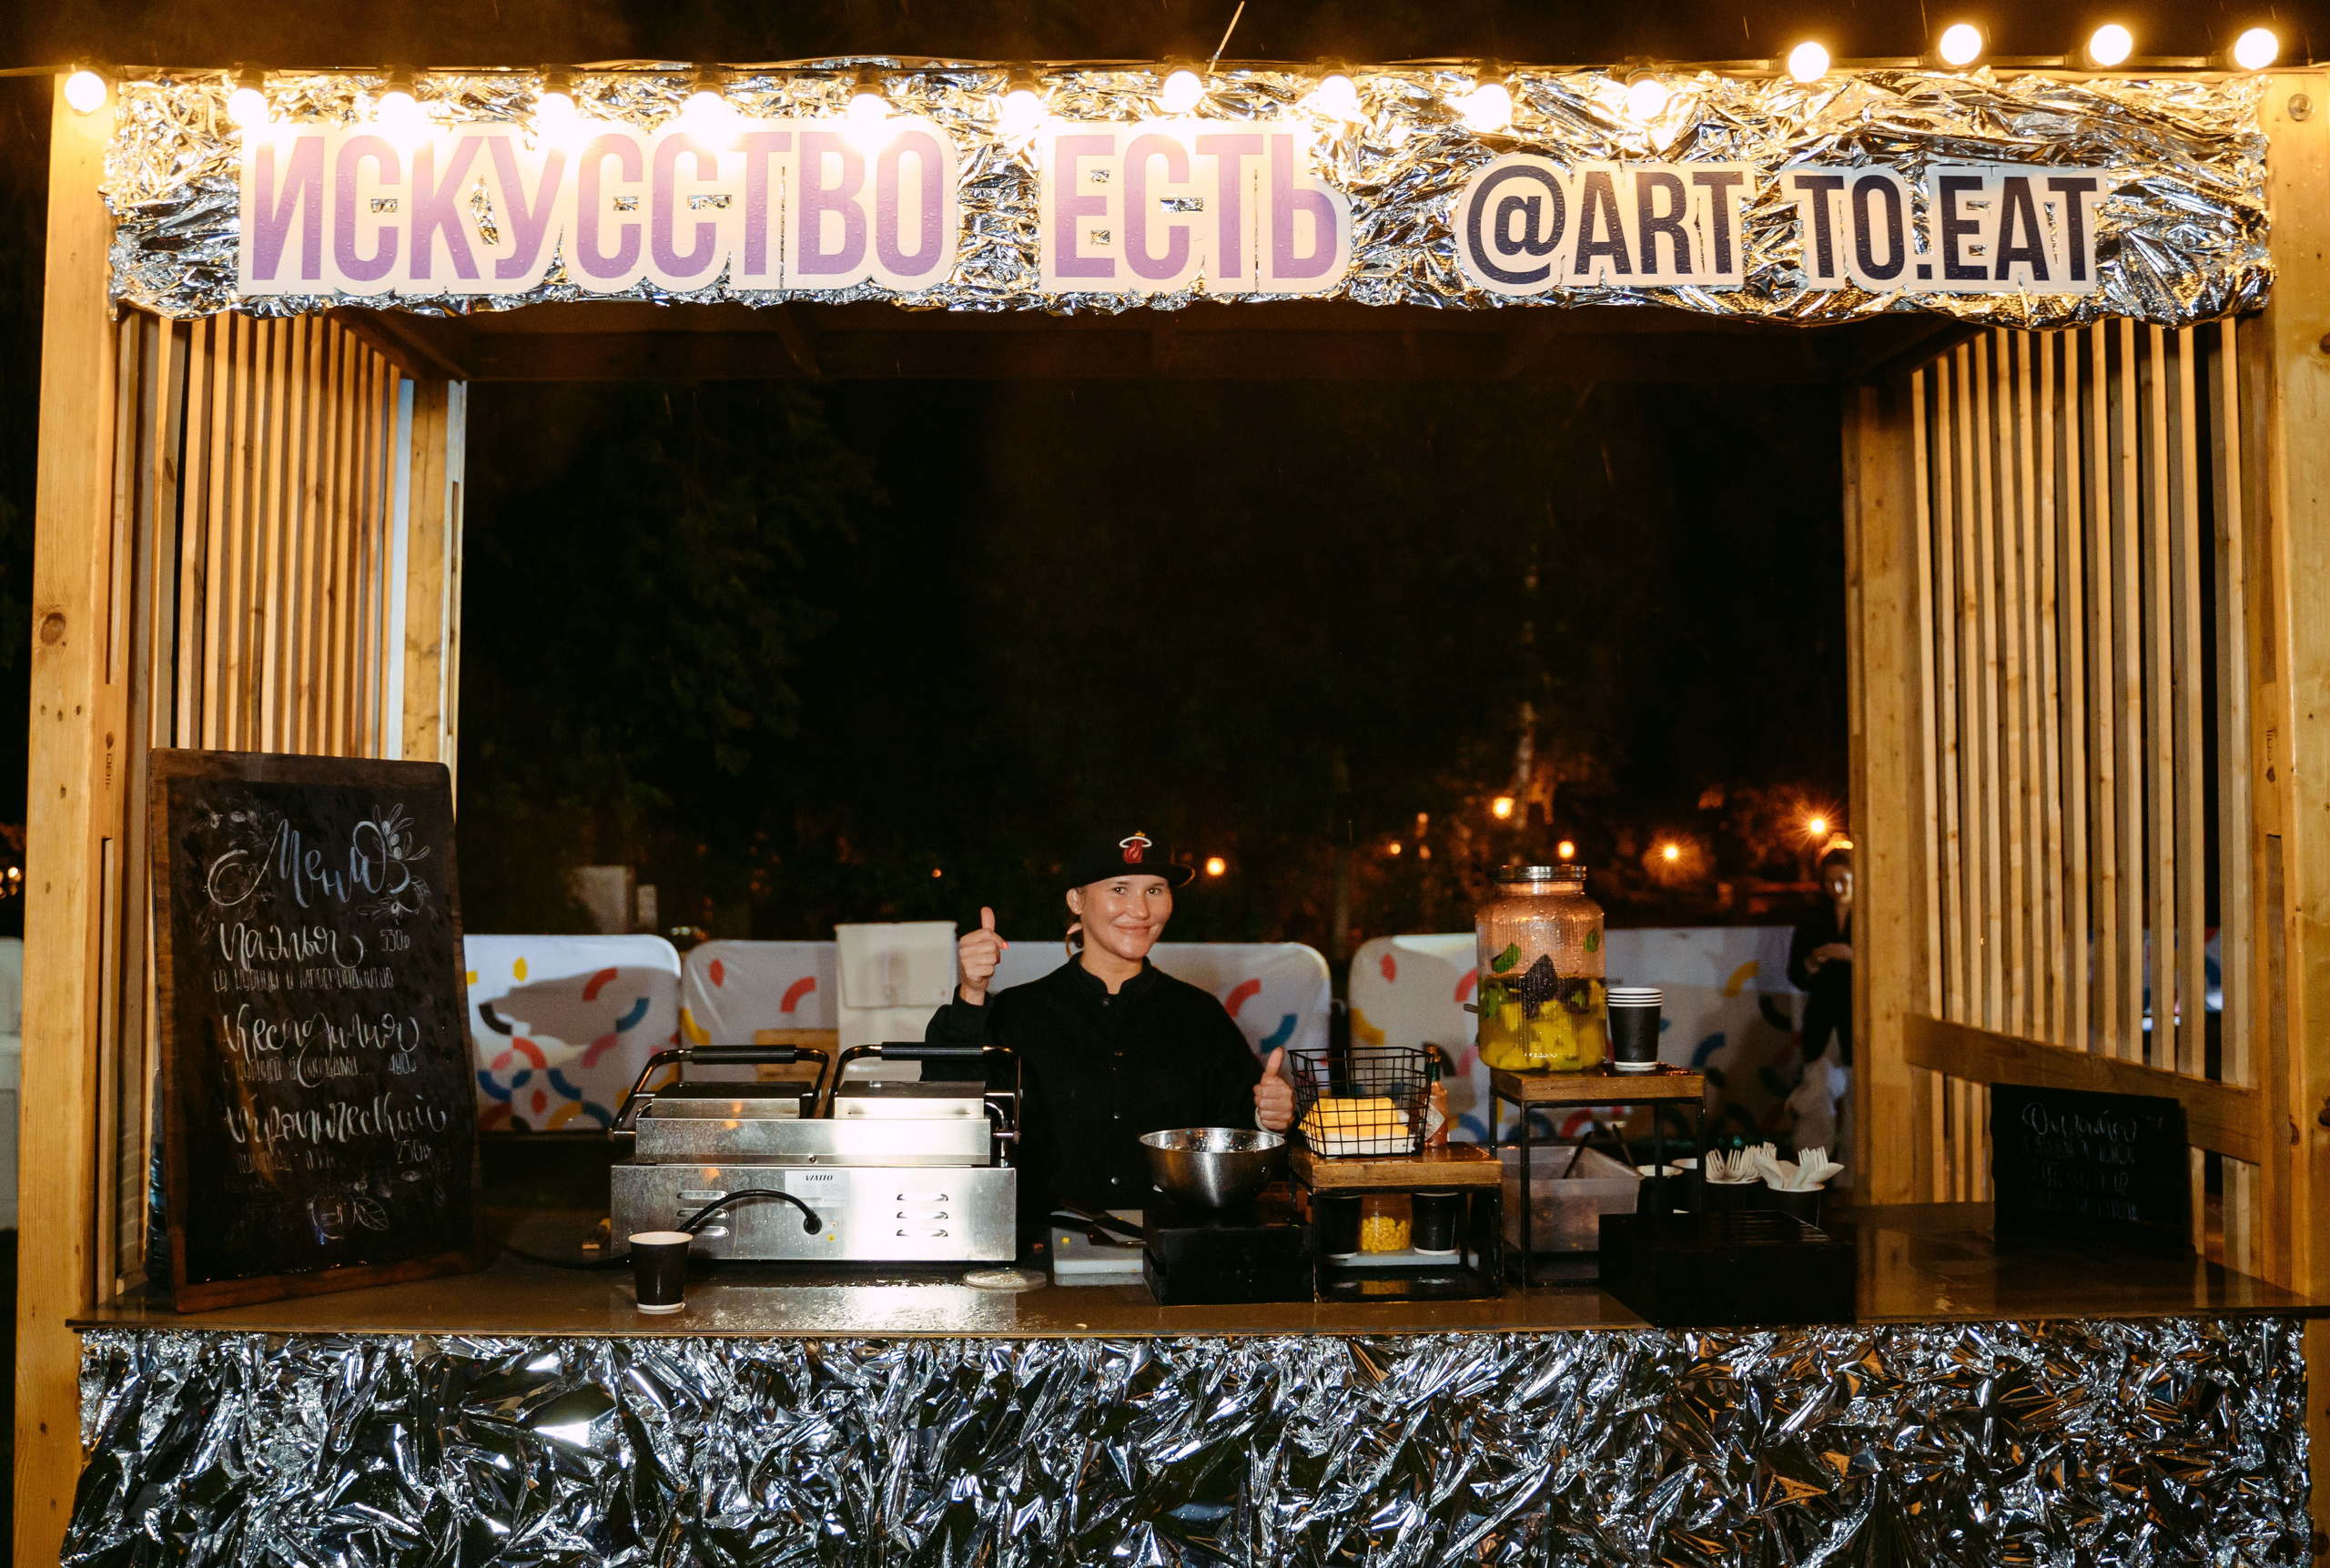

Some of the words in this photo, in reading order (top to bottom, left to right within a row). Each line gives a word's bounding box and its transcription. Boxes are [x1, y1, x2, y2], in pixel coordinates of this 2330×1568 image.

[251, 128, 943, 281] ИСКУССТВО
[1054, 133, 1338, 281] ЕСТЬ
[1465, 165, 1746, 286] @ART
[1794, 174, 2099, 284] TO.EAT
[208, 818, 410, 909] Меню
